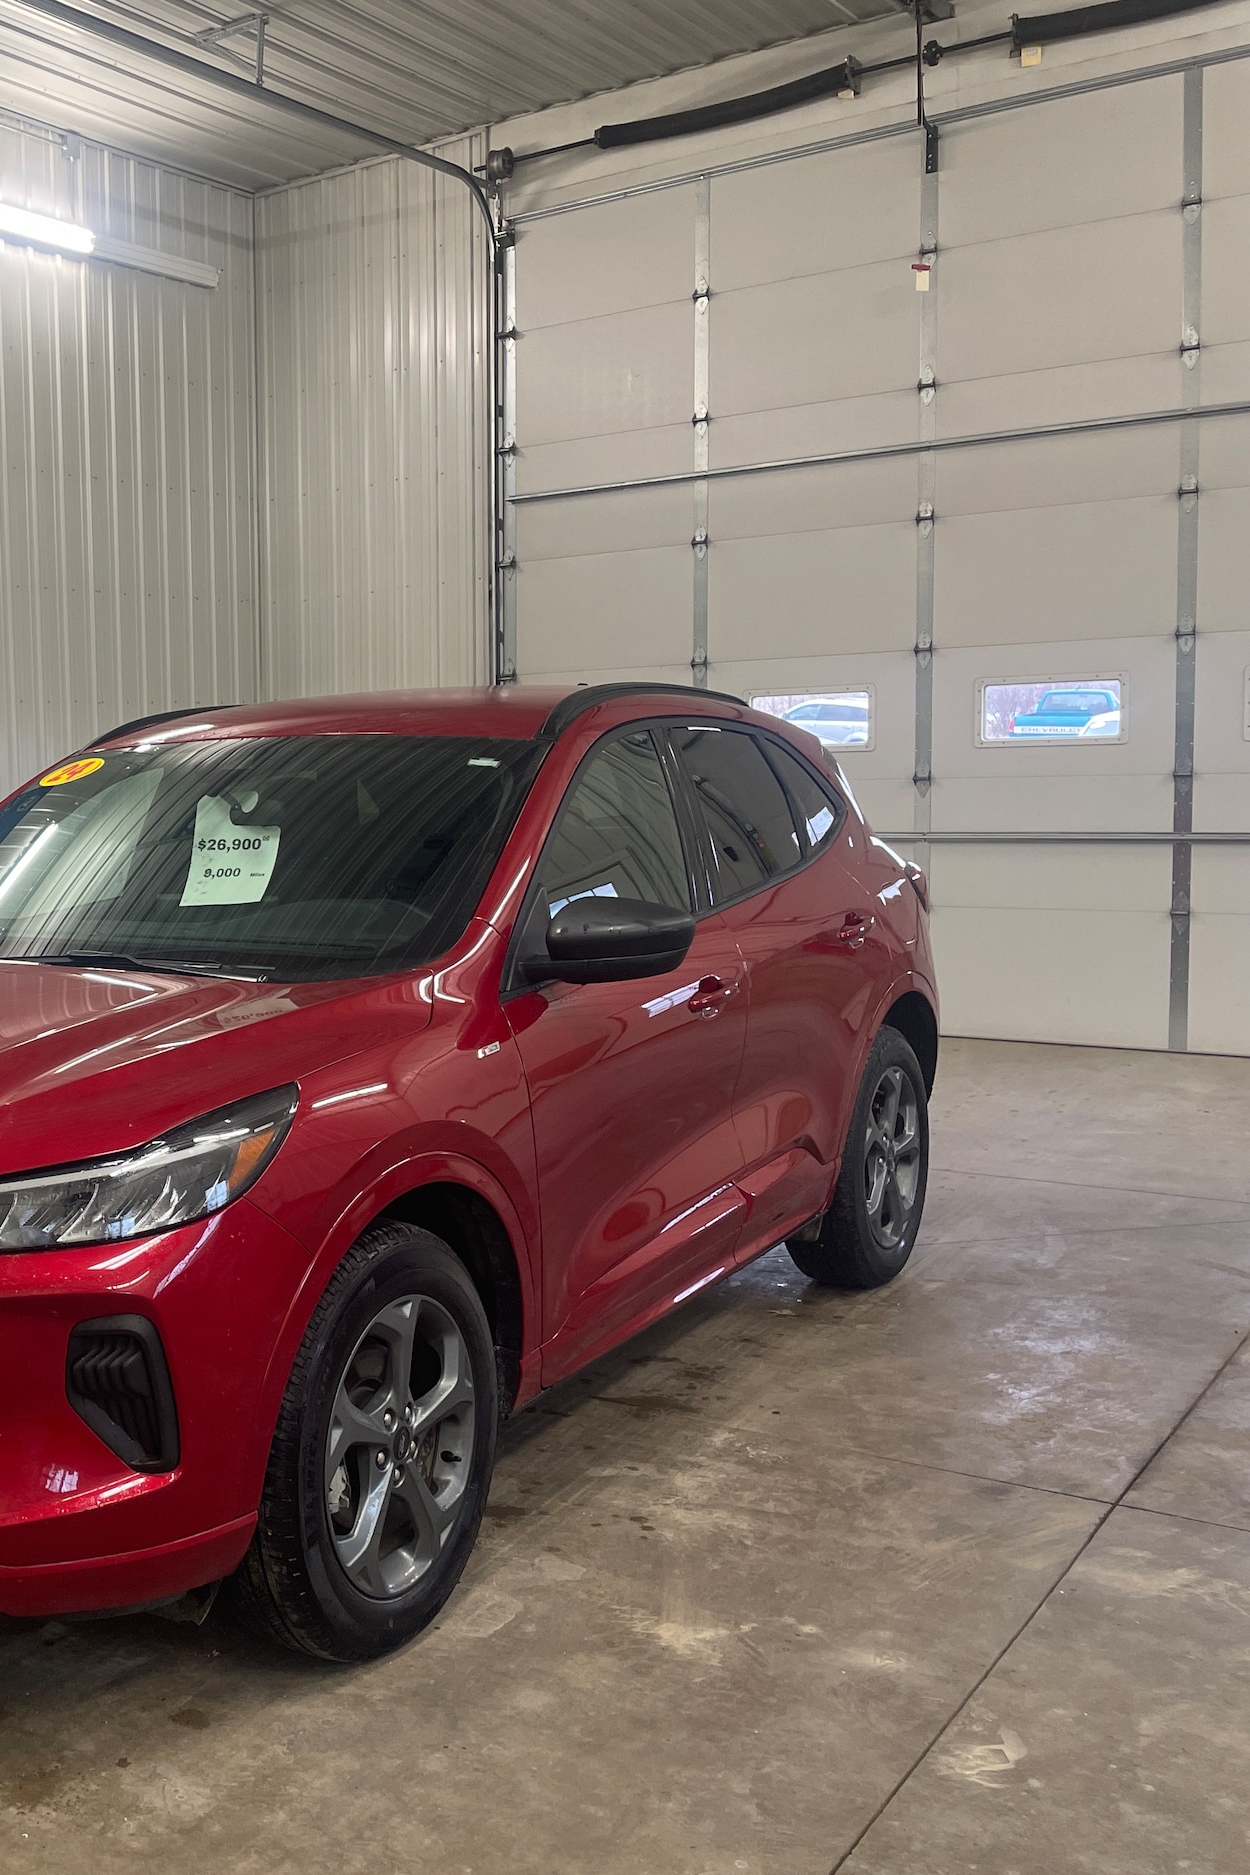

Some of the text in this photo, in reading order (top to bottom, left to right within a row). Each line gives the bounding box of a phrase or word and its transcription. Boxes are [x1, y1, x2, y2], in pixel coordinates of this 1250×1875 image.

[47, 761, 96, 782] 24
[197, 838, 261, 853] $26,900
[203, 868, 241, 879] 9,000
